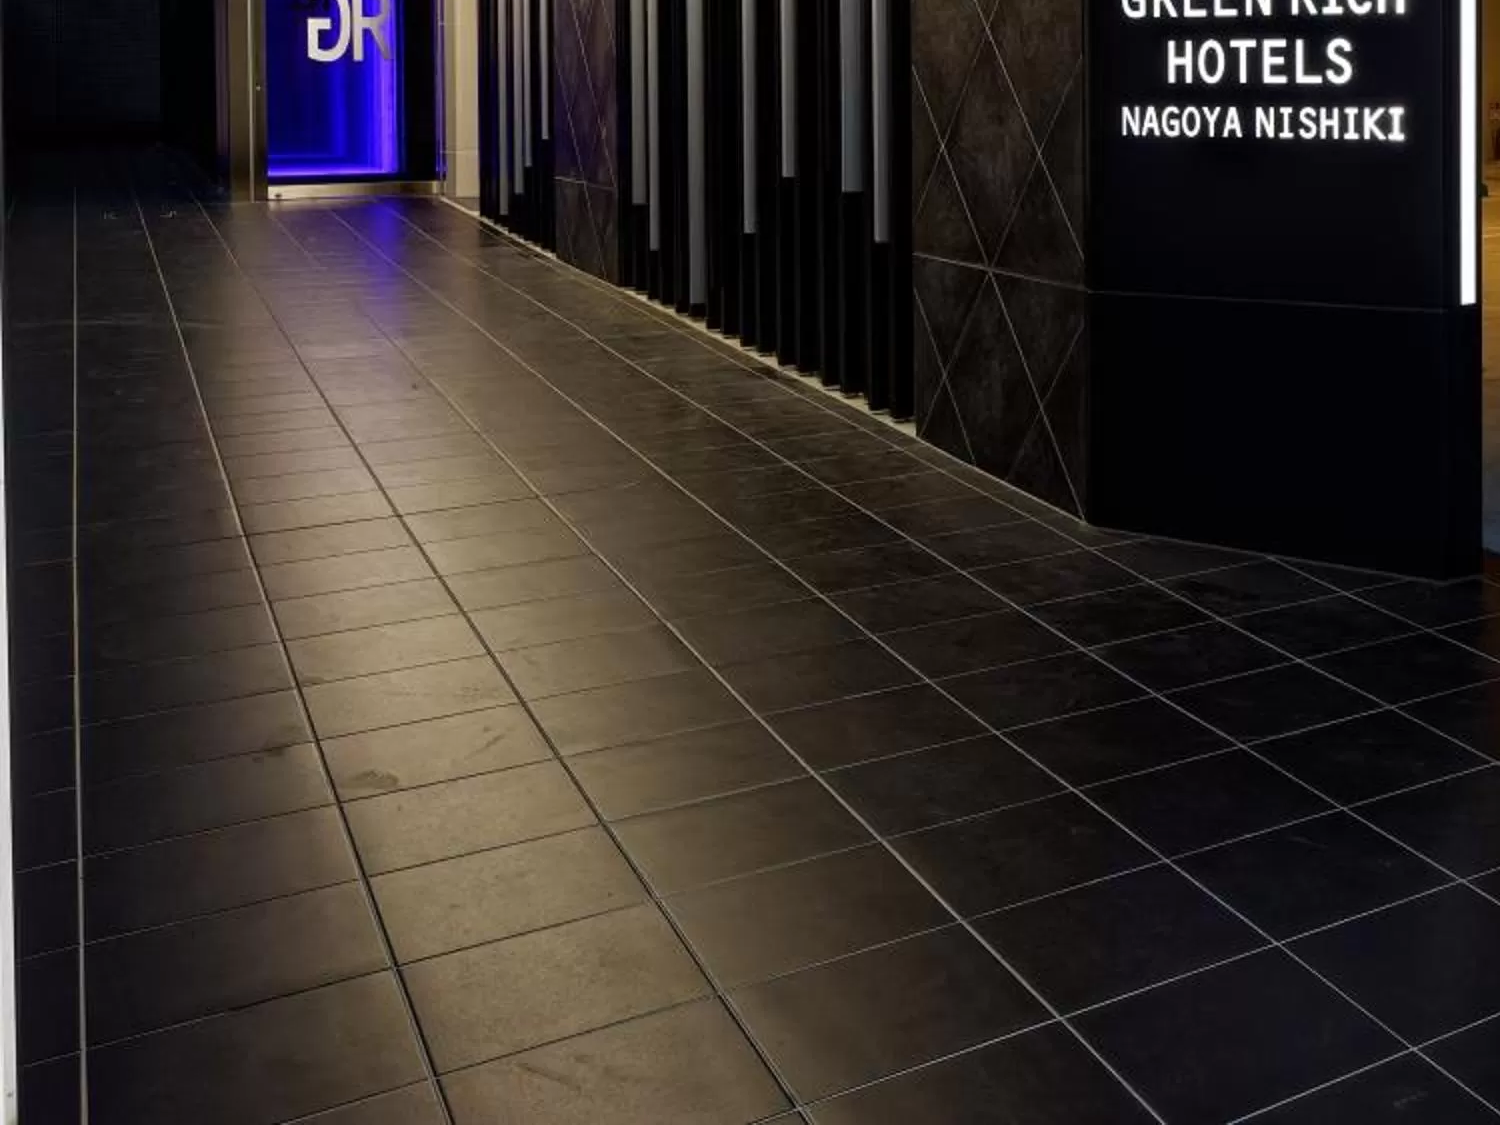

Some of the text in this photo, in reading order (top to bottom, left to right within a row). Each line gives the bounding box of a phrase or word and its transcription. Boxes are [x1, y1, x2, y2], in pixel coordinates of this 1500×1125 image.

[1167, 37, 1353, 84] HOTELS
[1121, 106, 1406, 142] NAGOYA NISHIKI
